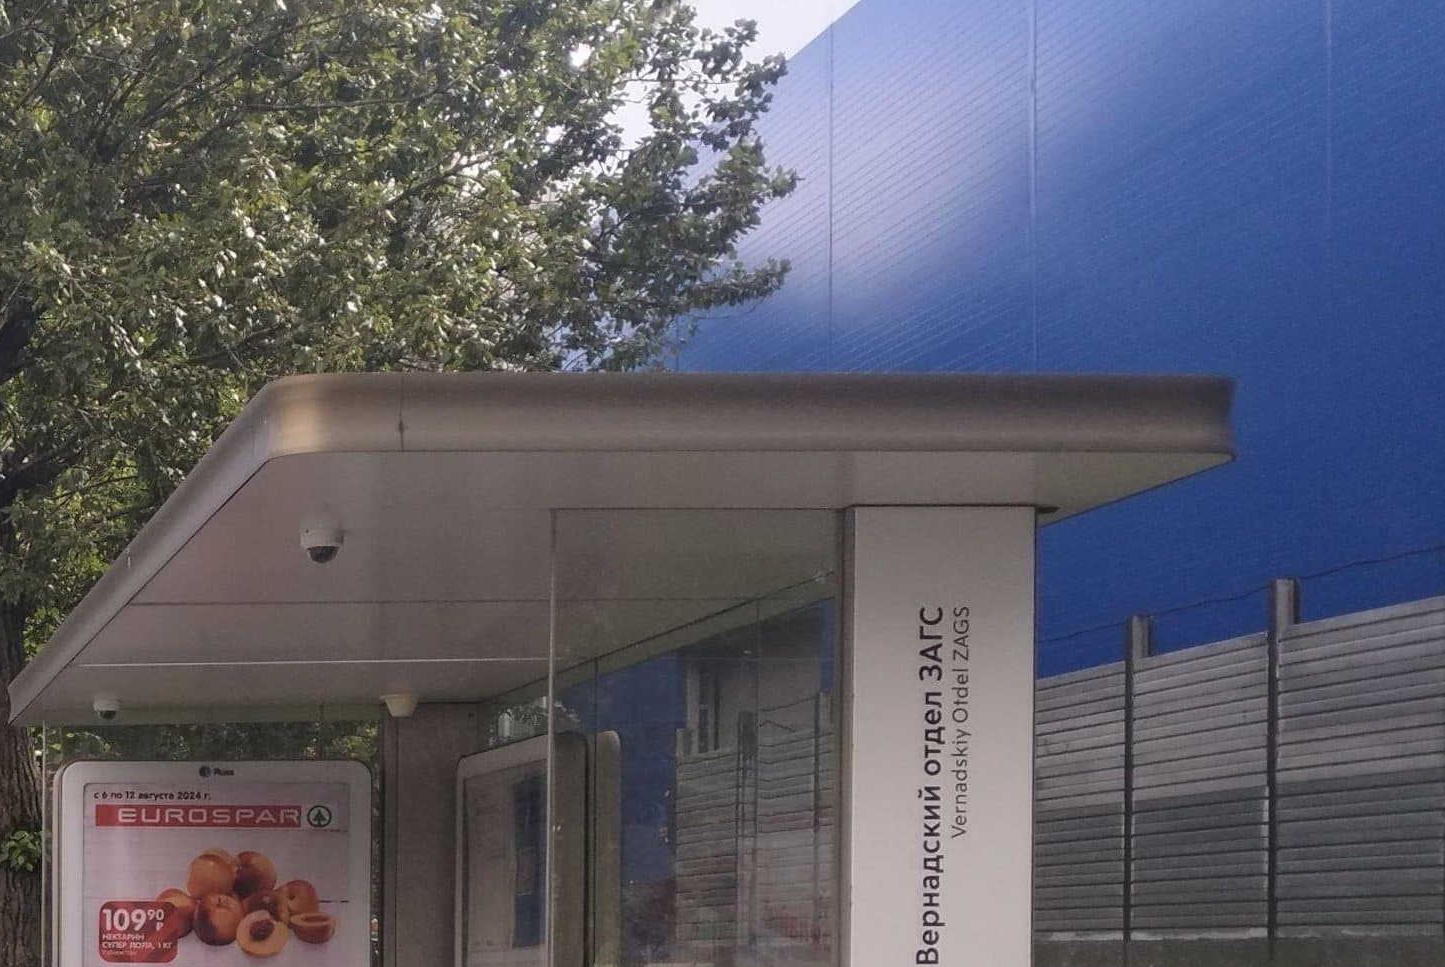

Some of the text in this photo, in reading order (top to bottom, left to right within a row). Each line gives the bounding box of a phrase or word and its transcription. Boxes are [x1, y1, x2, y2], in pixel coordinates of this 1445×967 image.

[951, 606, 972, 839] Vernadskiy Otdel ZAGS
[93, 791, 100, 800] с
[101, 790, 108, 800] 6
[110, 792, 124, 800] по
[125, 790, 136, 800] 12
[138, 792, 175, 802] августа
[177, 791, 202, 801] 2024
[916, 606, 946, 965] Вернадский отдел ЗАГС
[117, 807, 300, 825] EUROSPAR
[101, 908, 147, 932] 109
